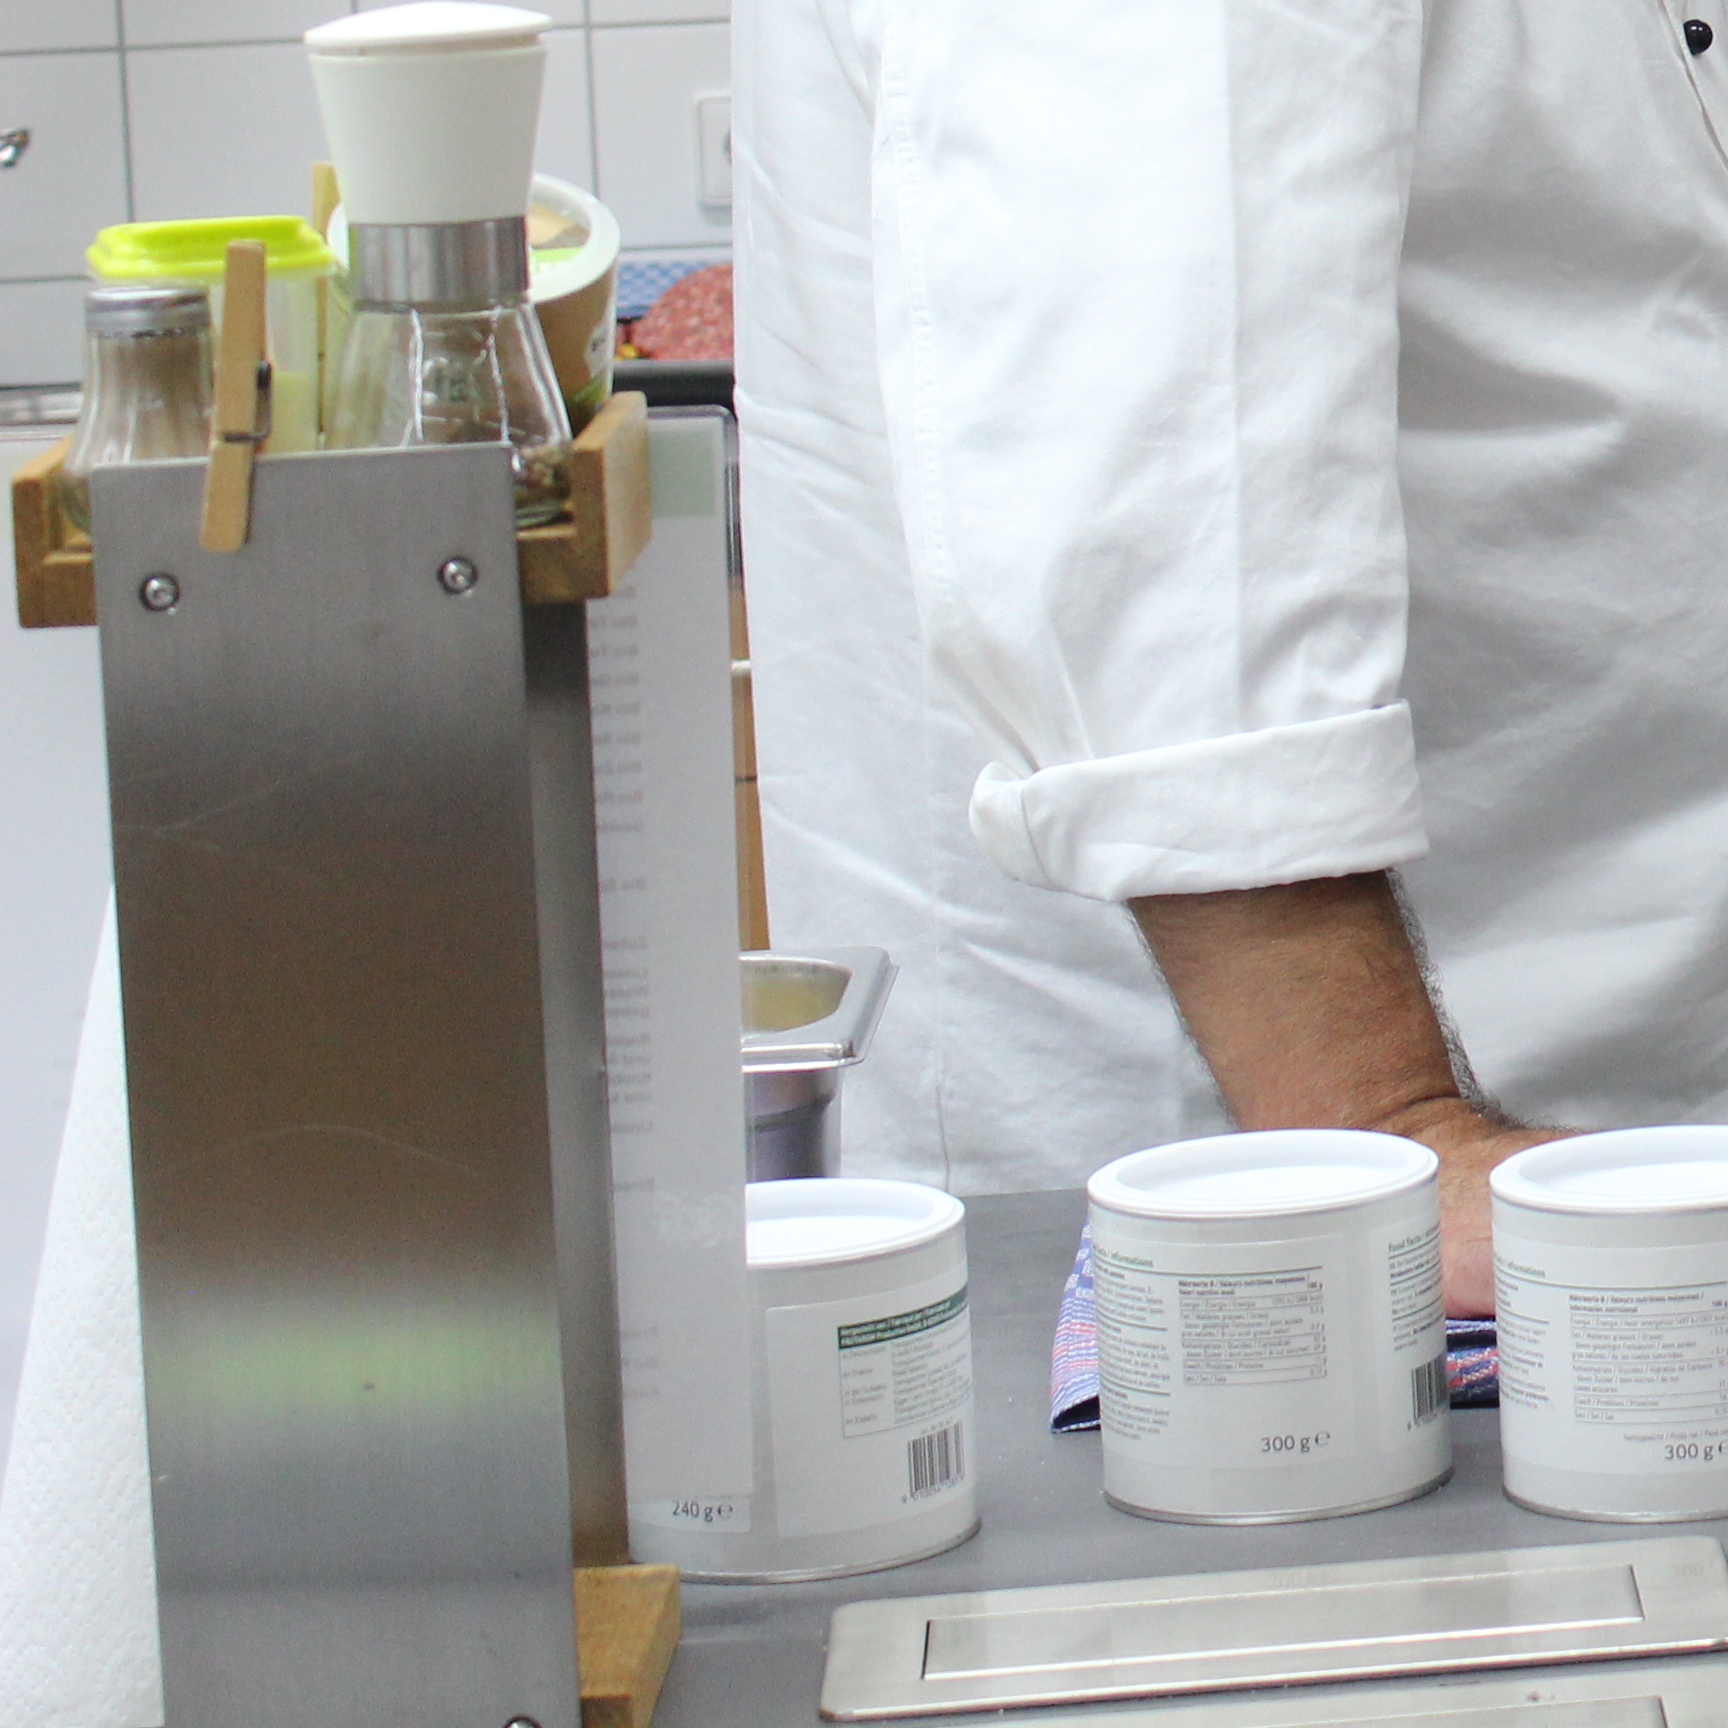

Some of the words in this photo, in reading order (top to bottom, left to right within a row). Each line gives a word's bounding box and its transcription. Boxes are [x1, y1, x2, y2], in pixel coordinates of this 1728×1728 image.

[1260, 1435, 1295, 1453] 300
[1300, 1436, 1310, 1453] g
[1664, 1443, 1699, 1460] 300
[1703, 1445, 1714, 1461] g
[673, 1500, 700, 1518] 240
[703, 1506, 713, 1522] g
